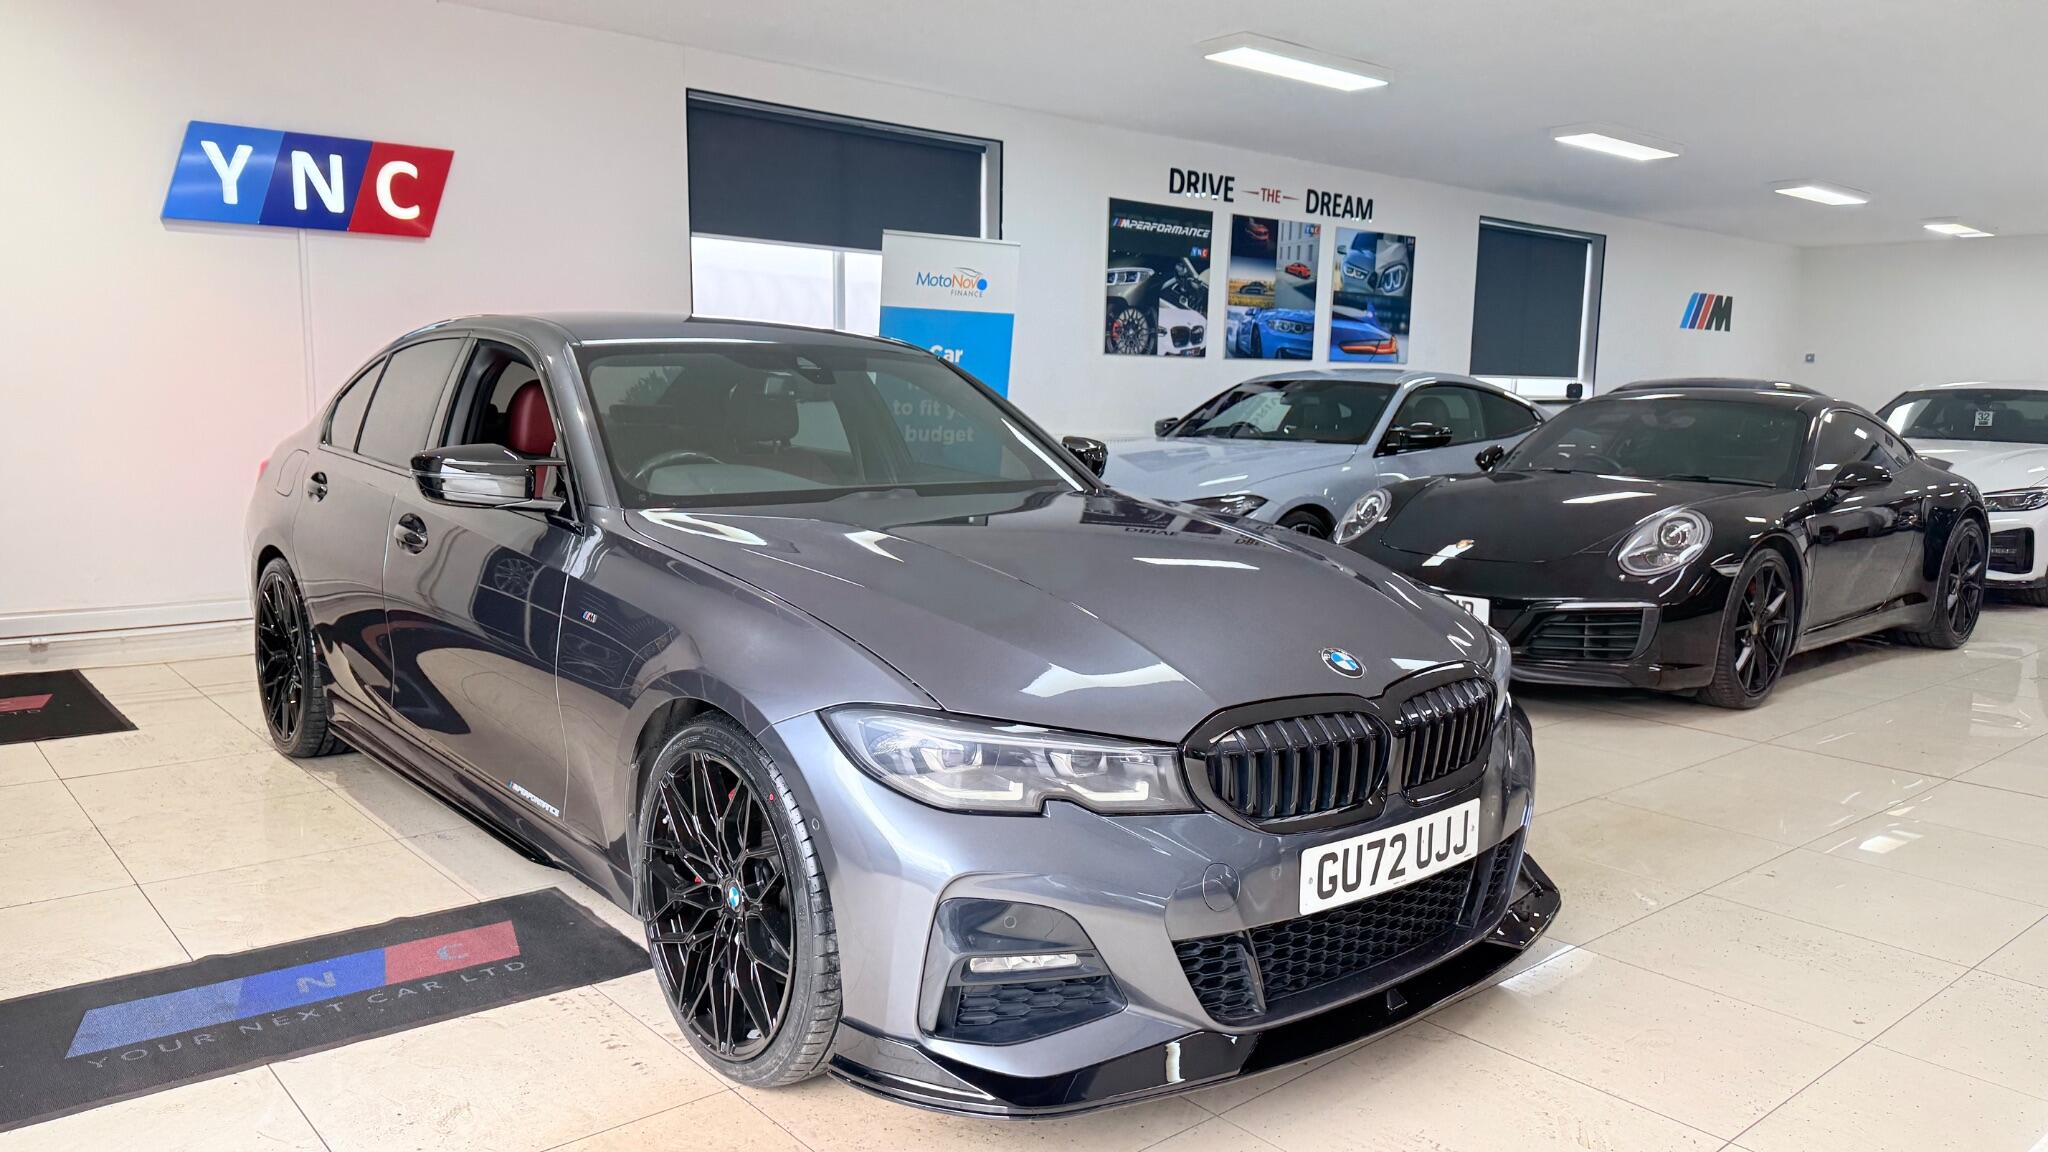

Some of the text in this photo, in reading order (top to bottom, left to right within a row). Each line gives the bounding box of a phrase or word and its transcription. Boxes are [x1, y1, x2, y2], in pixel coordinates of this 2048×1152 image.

[1169, 167, 1374, 223] DRIVE THE DREAM
[950, 289, 984, 299] FINANCE
[894, 399, 913, 416] to
[919, 399, 941, 417] fit
[905, 424, 976, 446] budget
[1316, 809, 1470, 900] GU72 UJJ
[87, 961, 526, 1069] YOUR NEXT CAR LTD
